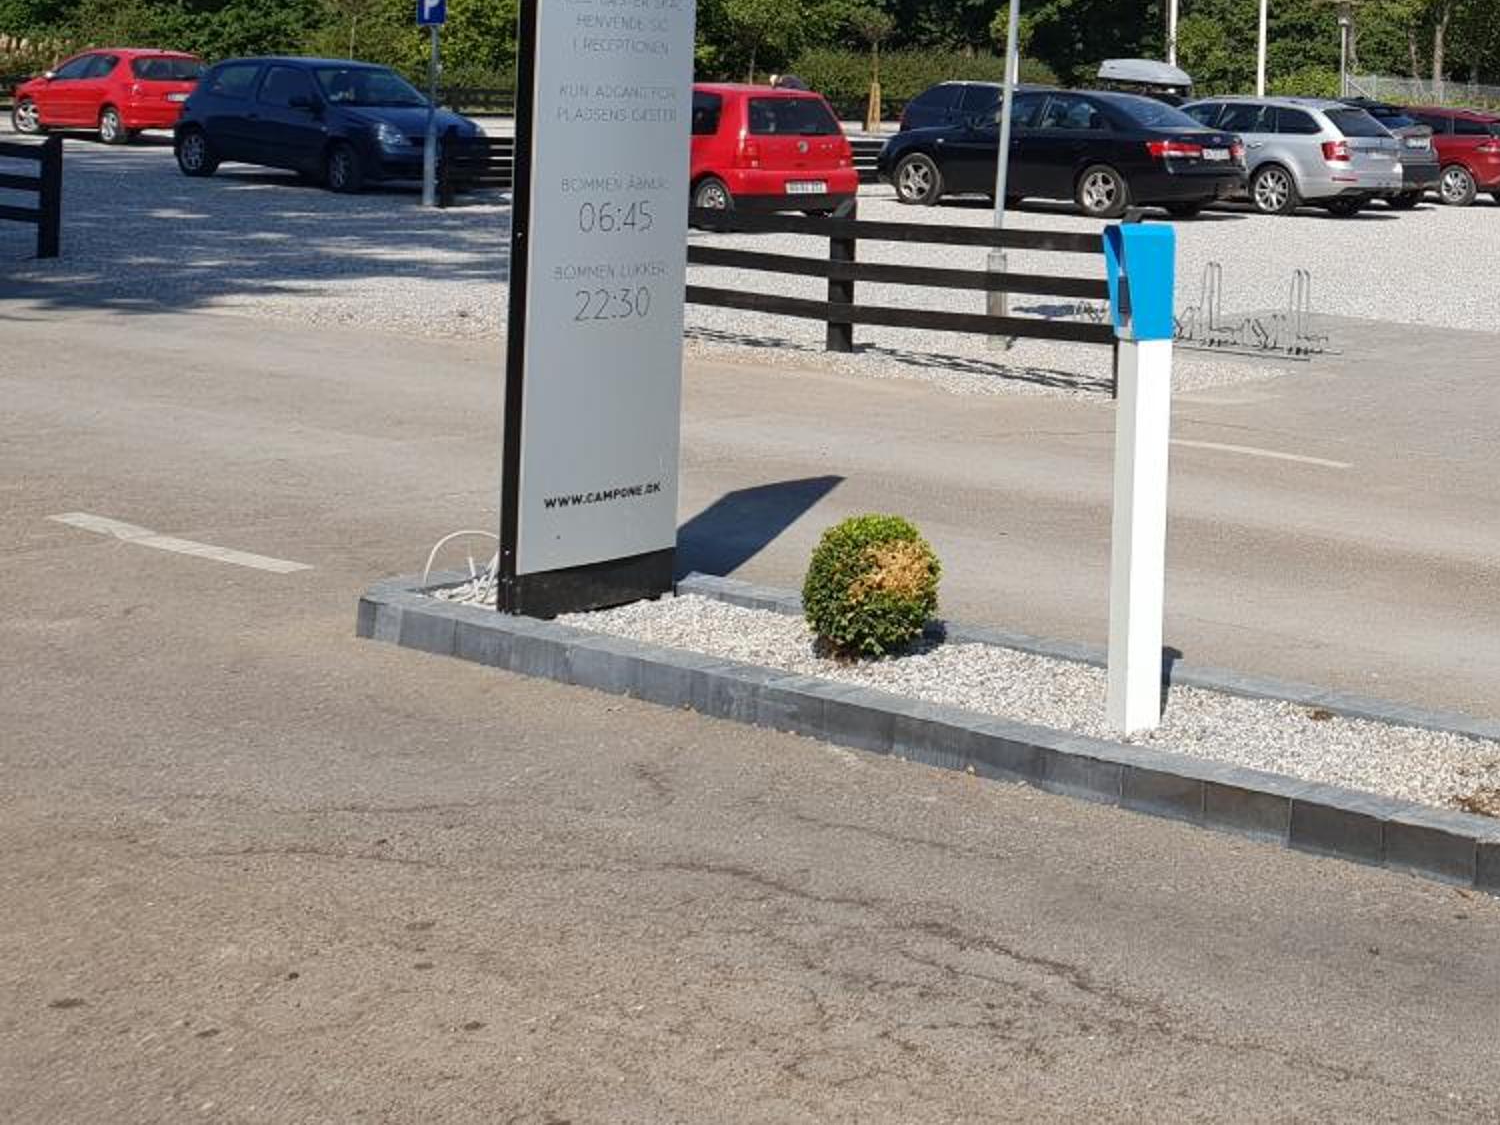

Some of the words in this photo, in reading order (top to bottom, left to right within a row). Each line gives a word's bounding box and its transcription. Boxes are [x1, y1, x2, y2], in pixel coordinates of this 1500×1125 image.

[576, 14, 644, 31] HENVENDE
[583, 36, 669, 55] RECEPTIONEN
[559, 85, 588, 99] KUN
[556, 107, 627, 123] PLADSENS
[561, 178, 623, 192] BOMMEN
[578, 200, 653, 232] 06:45
[554, 265, 616, 280] BOMMEN
[573, 286, 651, 322] 22:30
[543, 481, 662, 510] WWW.CAMPONE.DK
